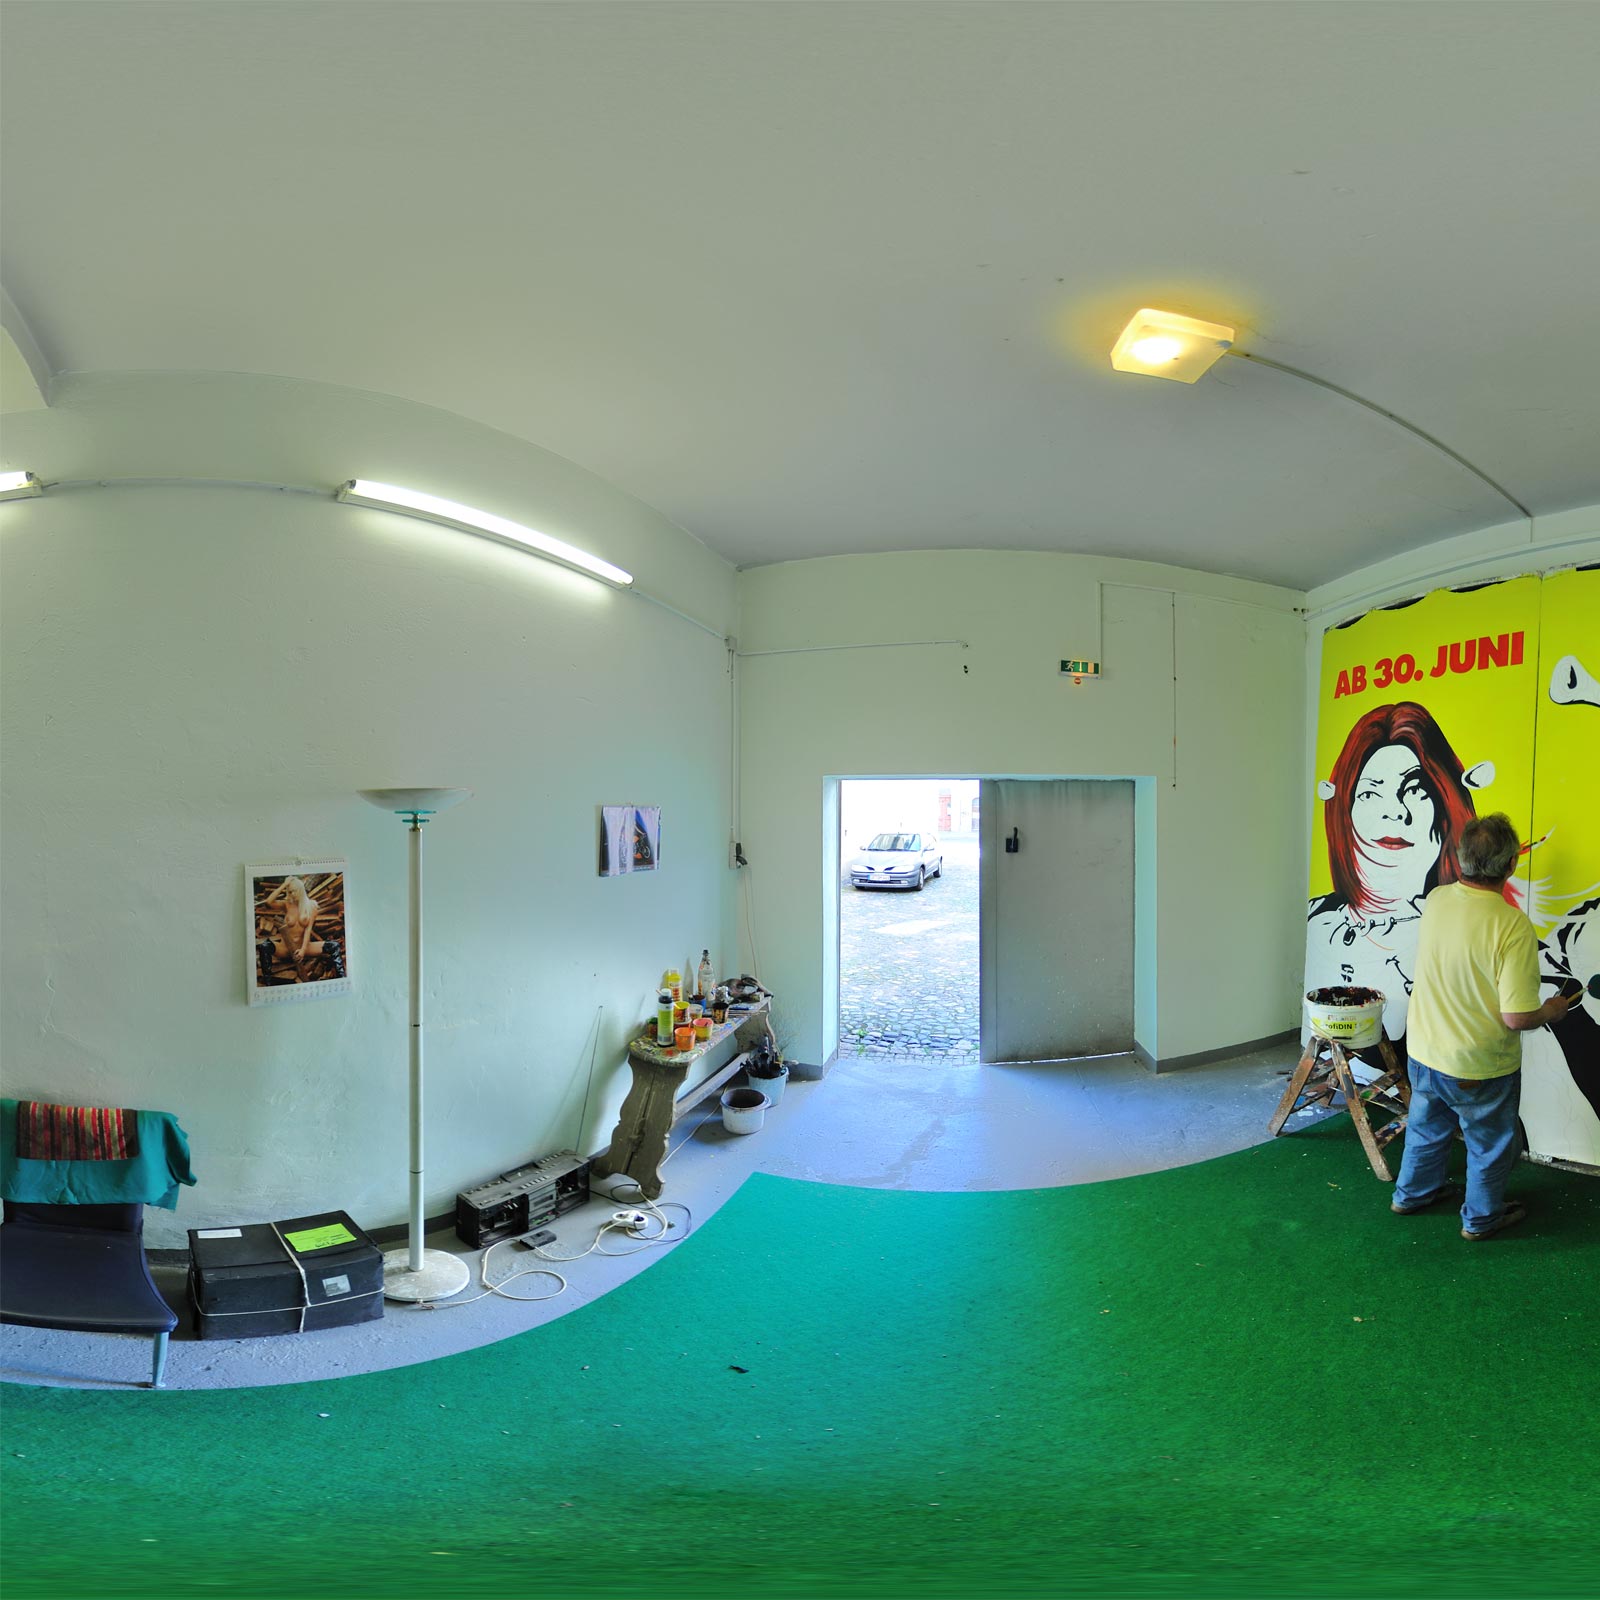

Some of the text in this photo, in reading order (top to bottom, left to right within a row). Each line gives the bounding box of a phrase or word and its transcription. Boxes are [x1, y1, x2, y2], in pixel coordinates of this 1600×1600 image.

[1334, 631, 1525, 699] AB 30. JUNI
